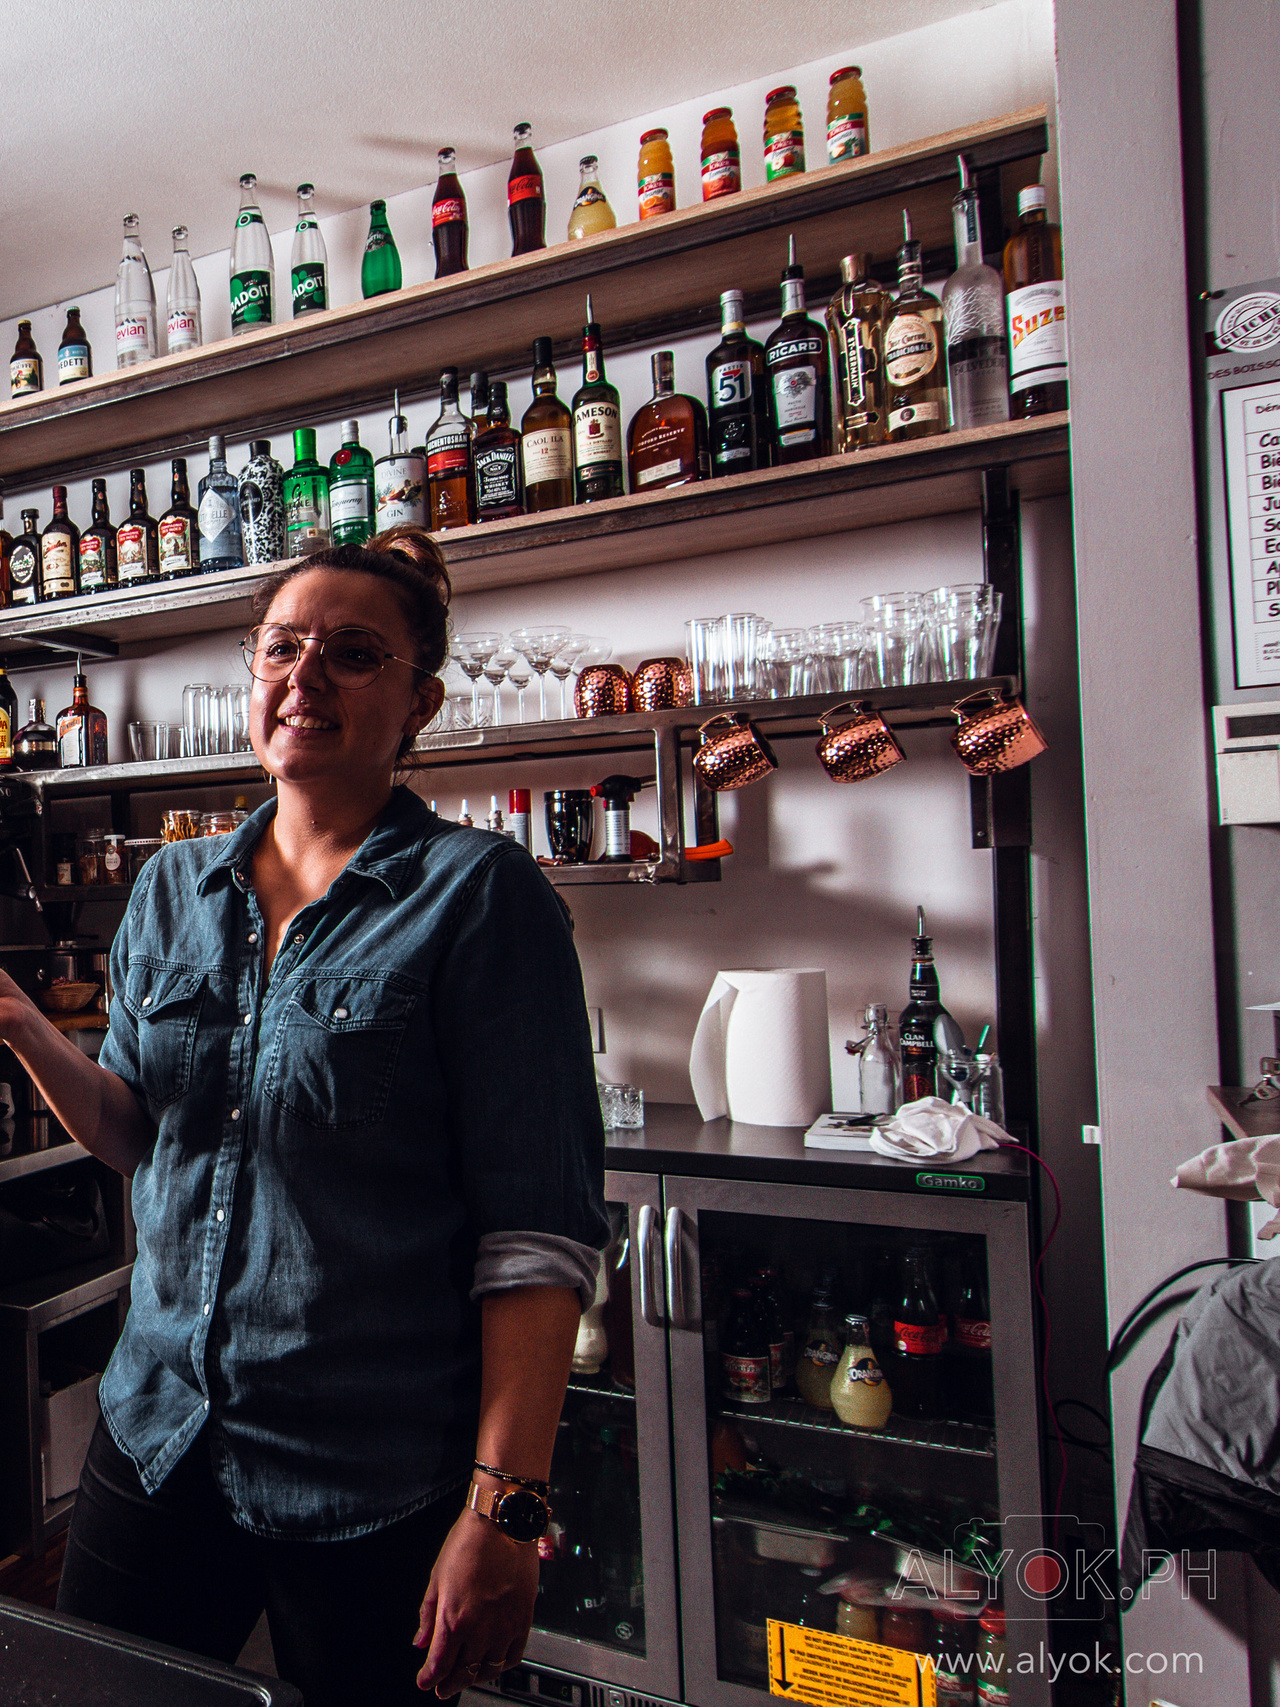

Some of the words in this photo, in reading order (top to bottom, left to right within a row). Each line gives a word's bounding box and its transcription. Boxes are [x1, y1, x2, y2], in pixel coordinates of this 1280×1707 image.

[293, 275, 323, 300] ADOIT
[116, 324, 145, 341] evian
[168, 317, 195, 335] evian
[1011, 304, 1066, 350] Suze
[769, 340, 818, 362] RICARD
[1207, 368, 1232, 380] DES
[719, 372, 746, 403] 51
[576, 406, 618, 424] AMESON
[526, 436, 549, 448] CAOL
[551, 435, 564, 443] ILA
[386, 508, 404, 518] GIN
[904, 1032, 926, 1041] CLAN
[922, 1174, 979, 1190] Gamko
